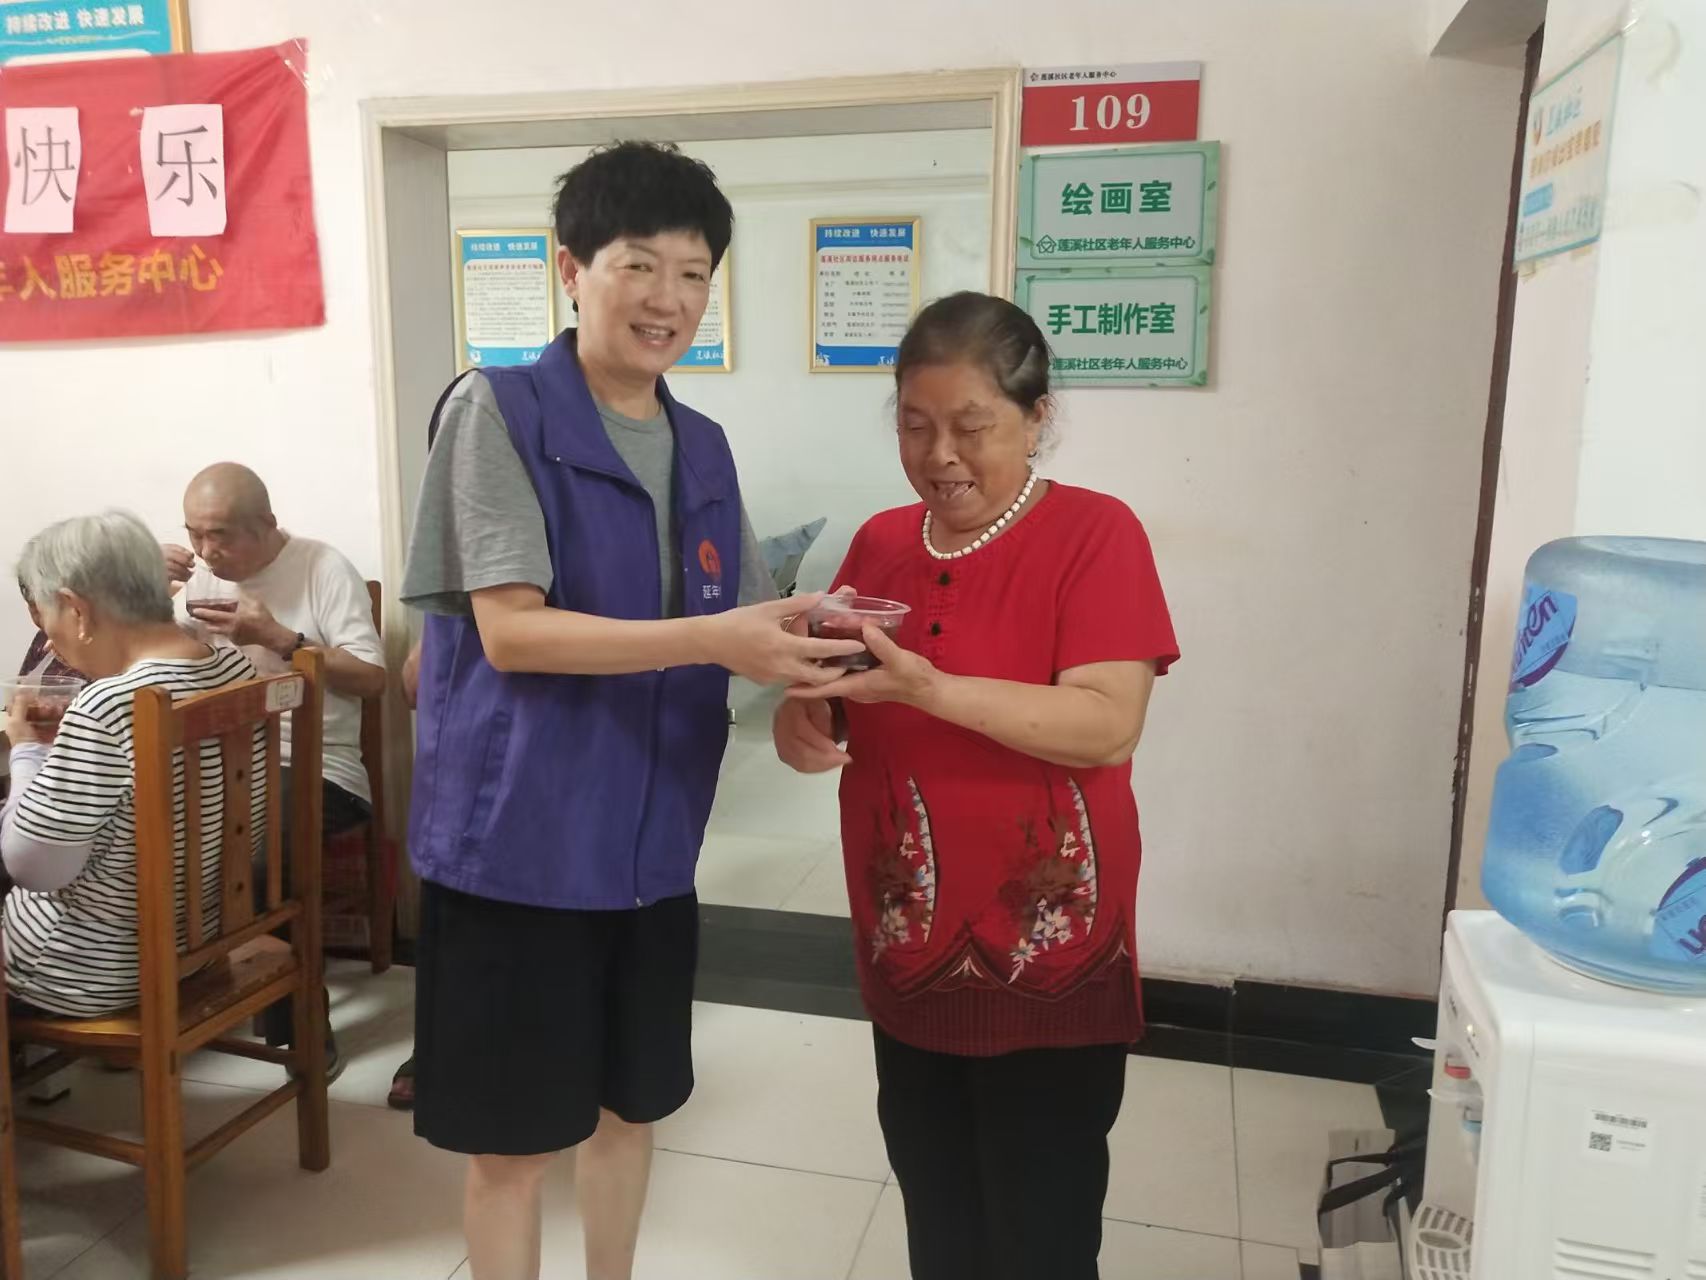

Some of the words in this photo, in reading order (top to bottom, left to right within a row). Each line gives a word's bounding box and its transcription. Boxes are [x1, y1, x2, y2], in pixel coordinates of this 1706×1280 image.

[1069, 93, 1151, 131] 109
[1061, 180, 1172, 215] 绘画室
[1047, 302, 1175, 335] 手工制作室
